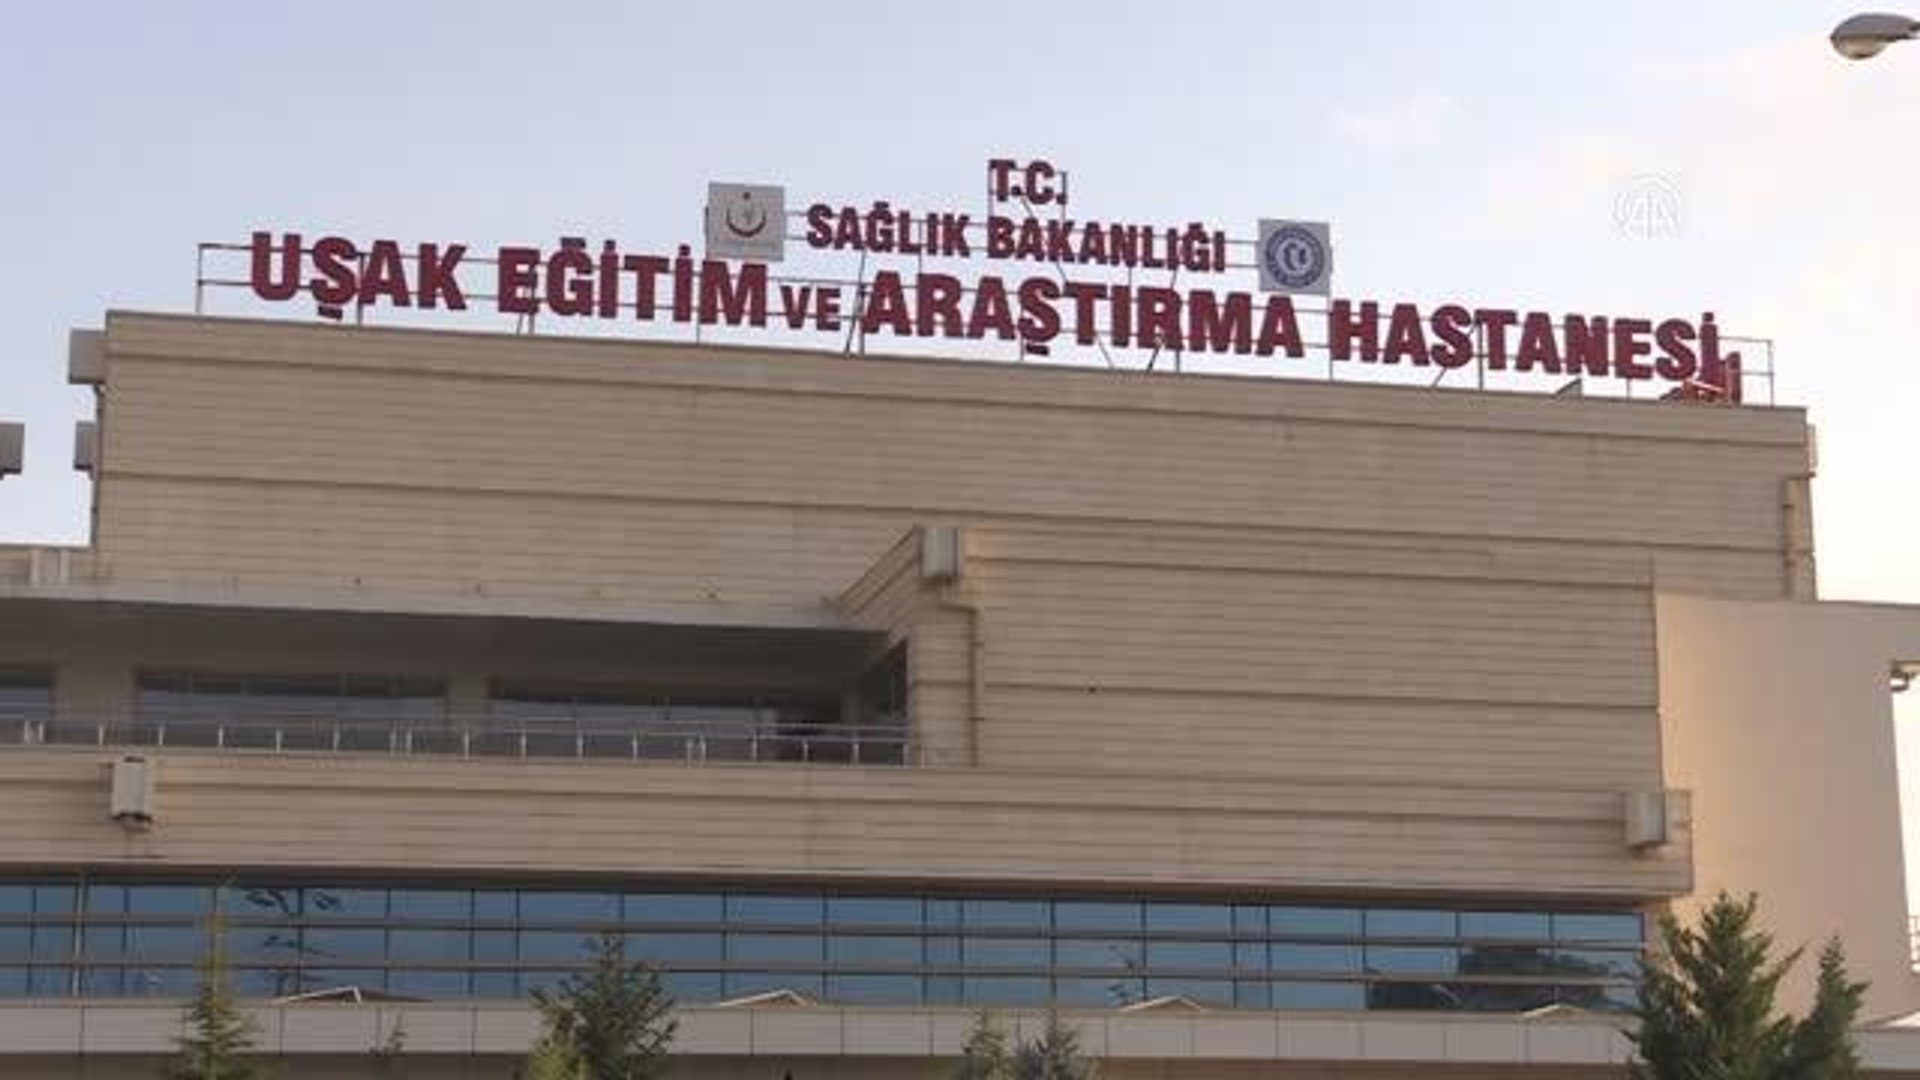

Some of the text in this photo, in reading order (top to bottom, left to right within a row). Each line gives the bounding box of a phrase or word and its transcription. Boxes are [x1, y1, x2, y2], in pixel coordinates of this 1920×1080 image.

[989, 159, 1067, 205] T.C.
[806, 201, 970, 257] SAĞLIK
[987, 215, 1226, 273] BAKANLIĞI
[251, 232, 1719, 383] UŞAK EĞİTİM VE ARAŞTIRMA HASTANESİ
